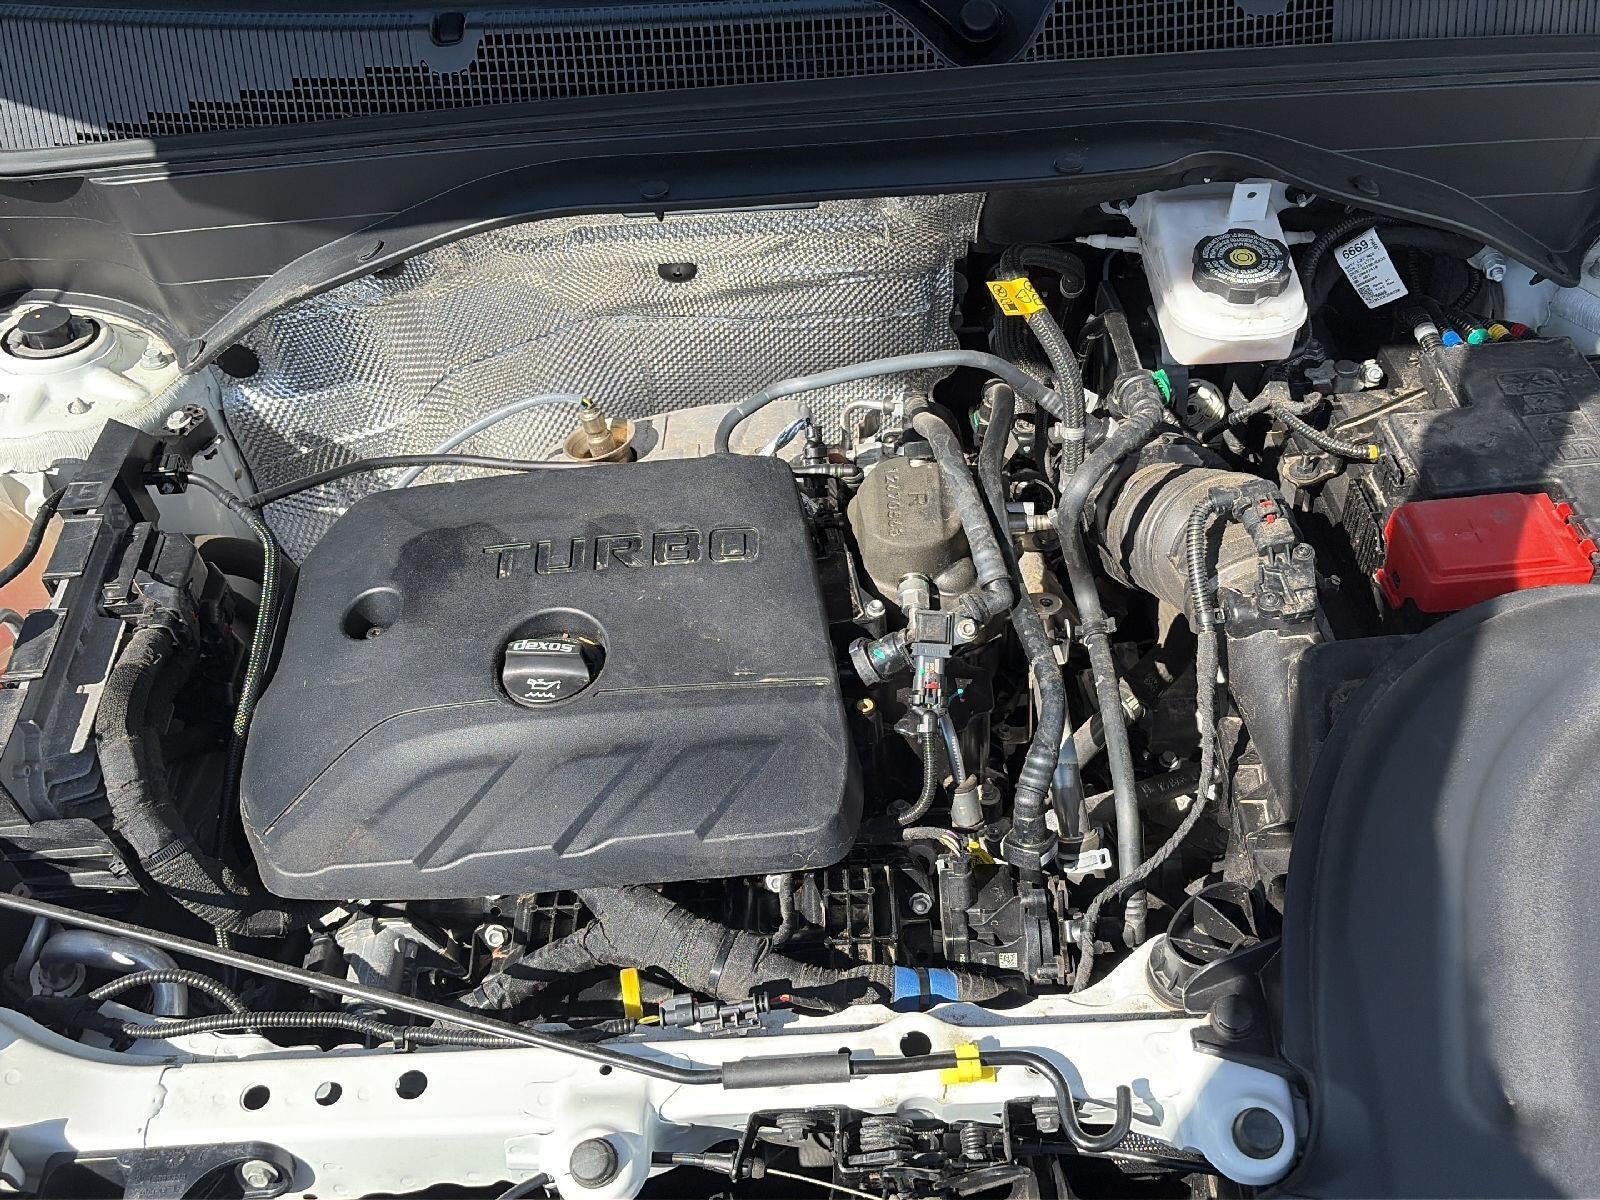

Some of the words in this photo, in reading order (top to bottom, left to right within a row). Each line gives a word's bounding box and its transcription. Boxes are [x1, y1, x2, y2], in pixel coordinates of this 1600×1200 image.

[1342, 239, 1369, 259] 6669
[482, 526, 760, 579] TURBO
[513, 639, 576, 652] dexos
